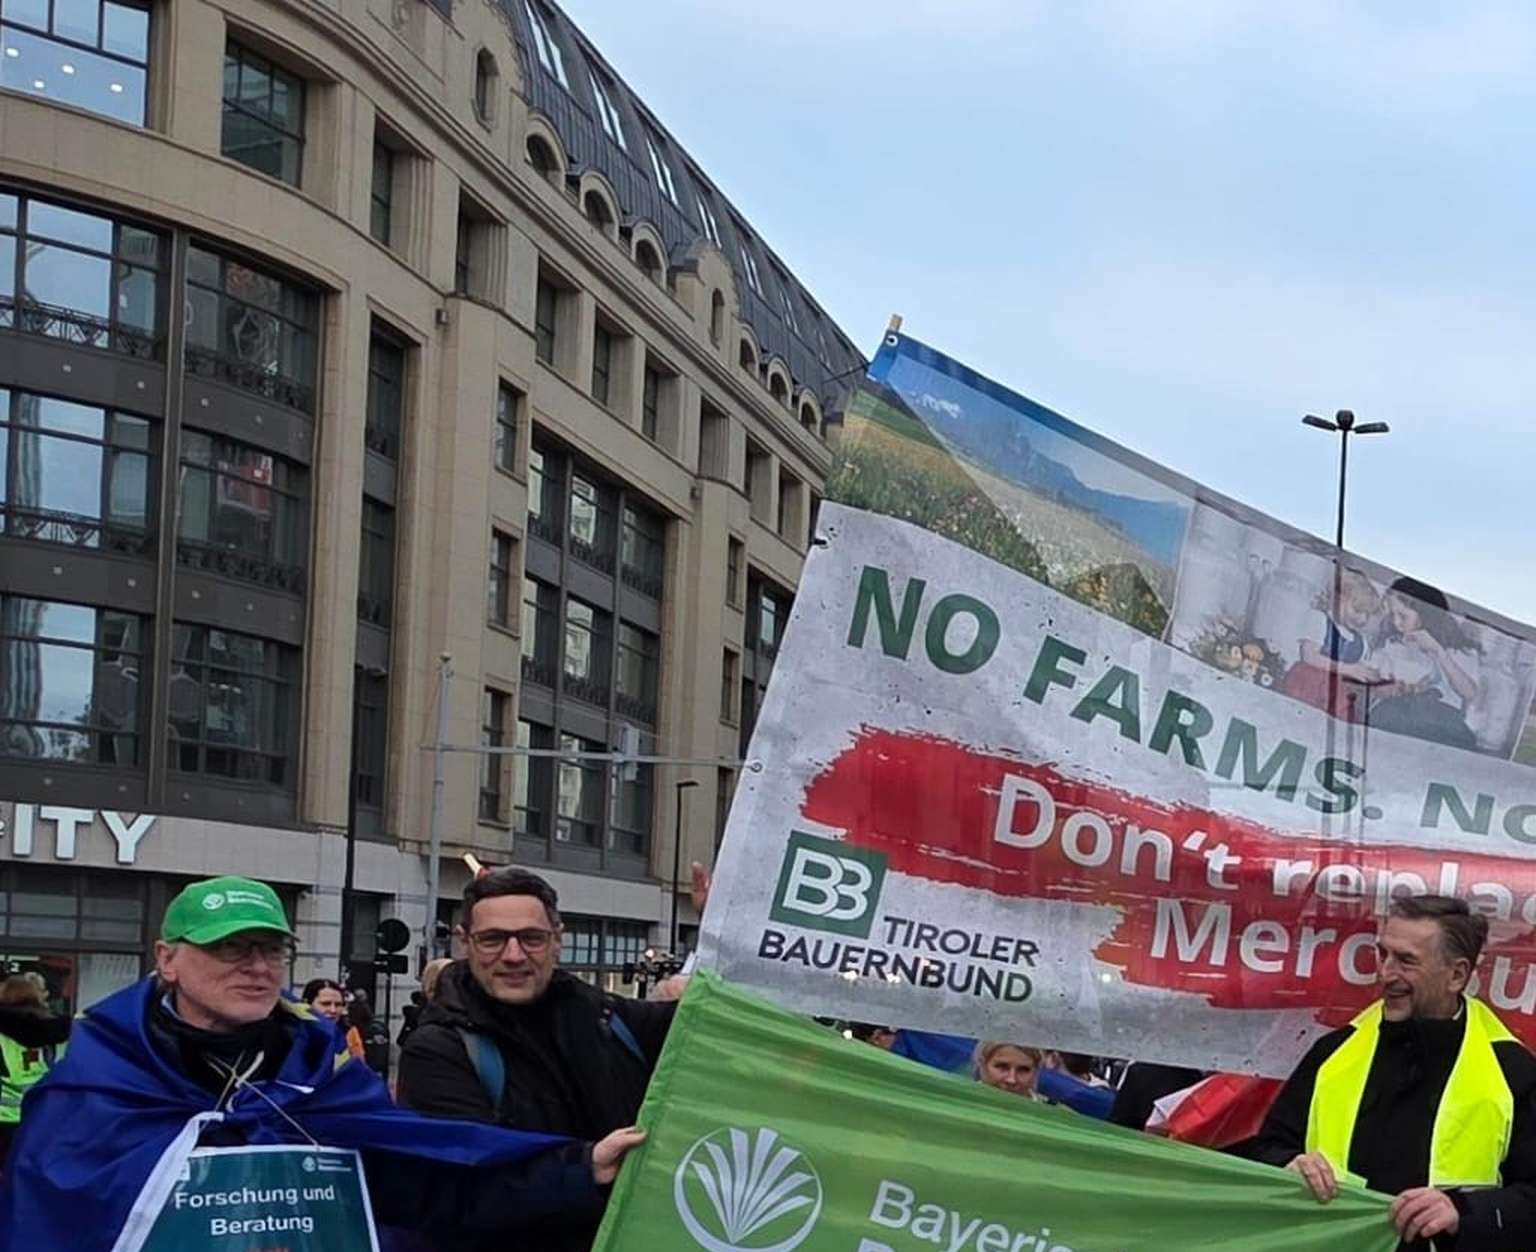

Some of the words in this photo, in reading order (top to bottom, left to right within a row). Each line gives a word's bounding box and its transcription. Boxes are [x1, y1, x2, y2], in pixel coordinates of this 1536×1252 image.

[847, 565, 1001, 675] NO
[1023, 635, 1385, 820] FARMS.
[0, 803, 157, 864] ITY
[757, 929, 1033, 1002] BAUERNBUND
[883, 916, 1039, 967] TIROLER
[174, 1187, 298, 1210] Forschung
[303, 1185, 335, 1201] und
[210, 1215, 315, 1236] Beratung
